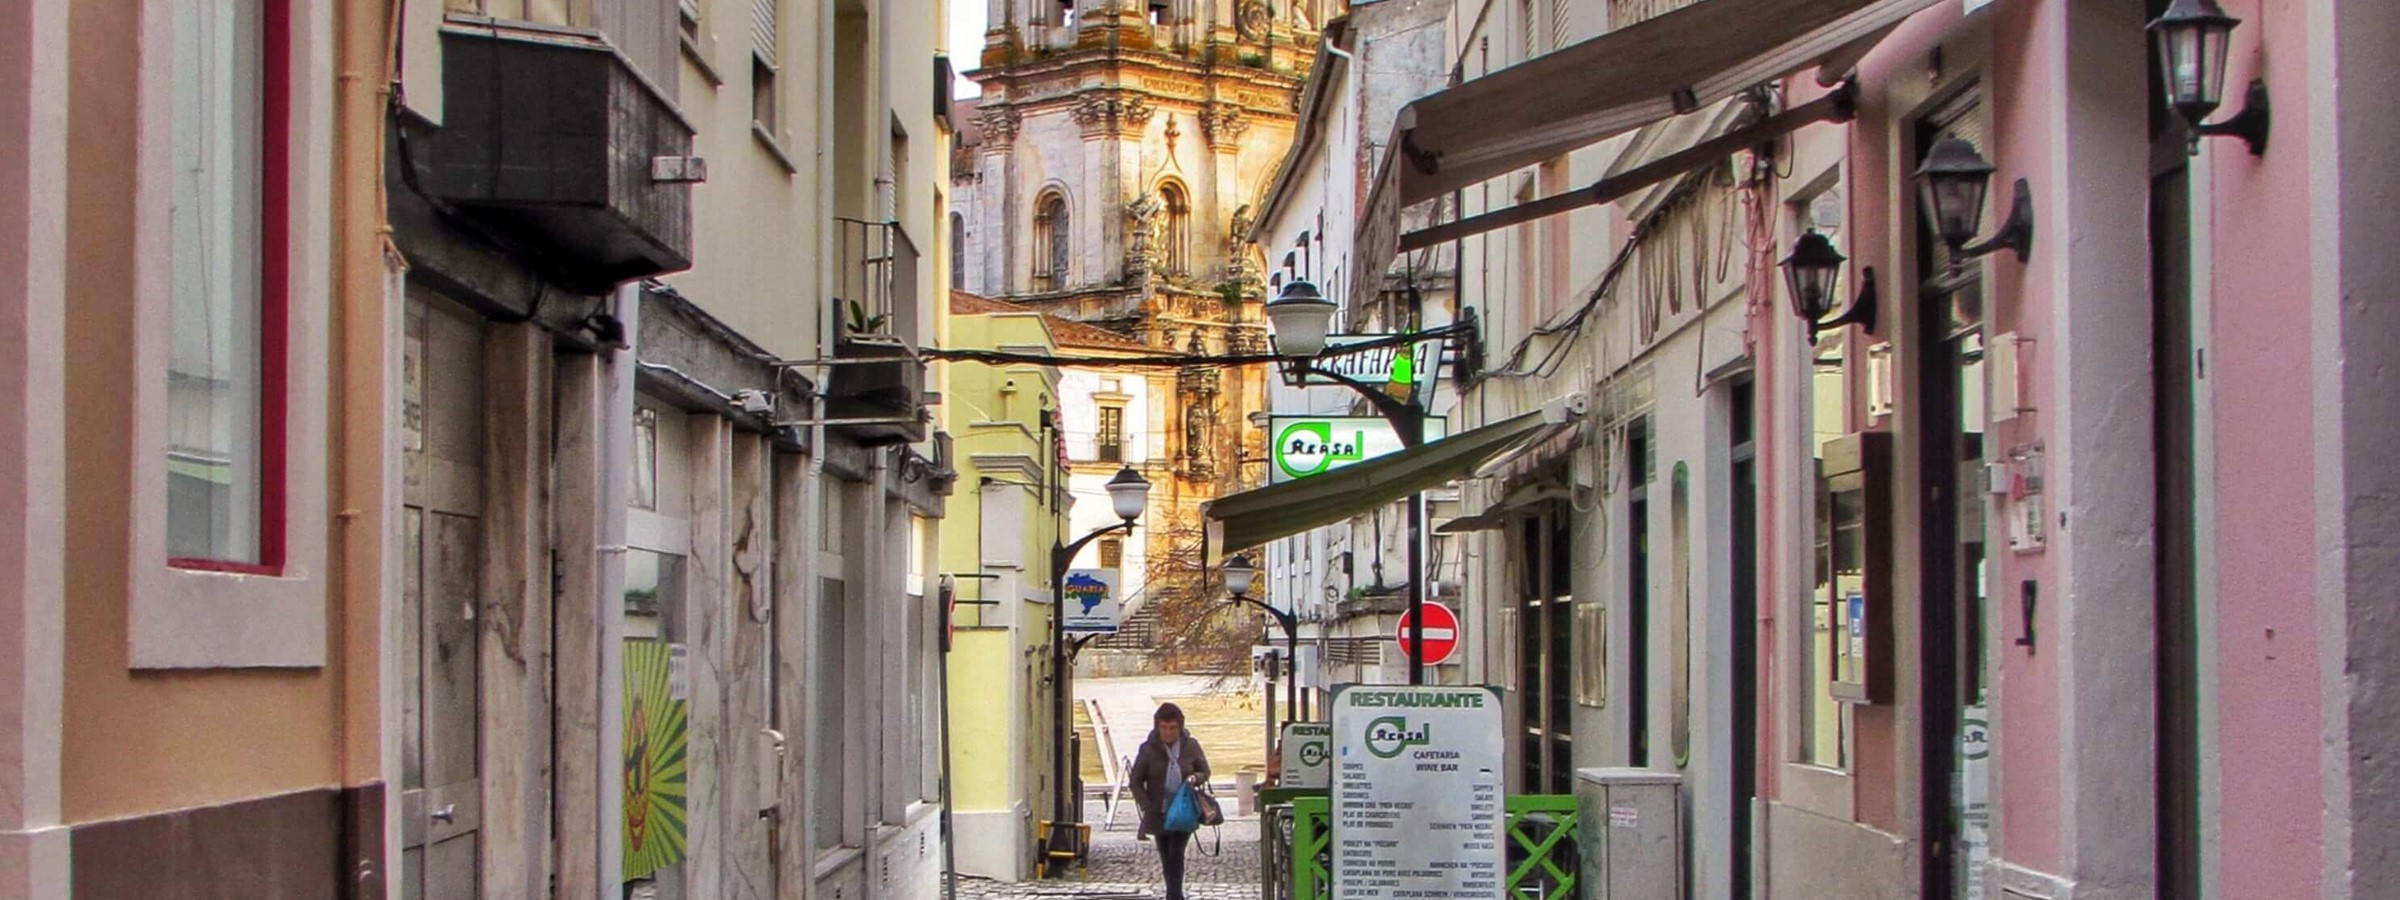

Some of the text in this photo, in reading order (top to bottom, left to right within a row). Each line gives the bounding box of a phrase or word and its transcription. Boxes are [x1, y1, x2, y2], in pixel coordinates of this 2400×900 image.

[1350, 692, 1484, 708] RESTAURANTE
[1413, 751, 1460, 760] CAFETARIA
[1416, 763, 1458, 772] WINE BAR
